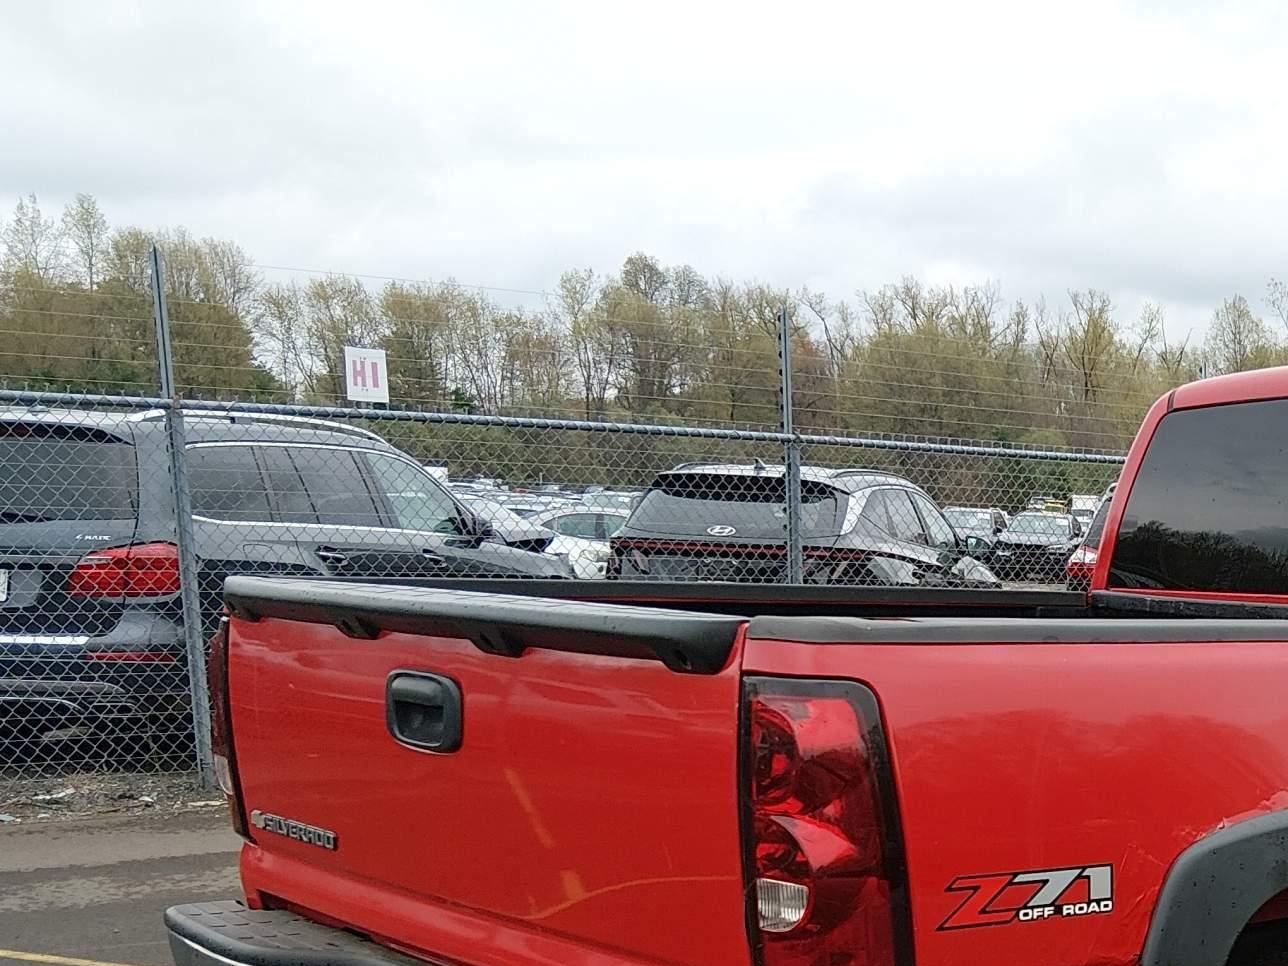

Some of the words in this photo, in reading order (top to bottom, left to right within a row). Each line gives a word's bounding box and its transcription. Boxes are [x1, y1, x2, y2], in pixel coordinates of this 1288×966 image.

[264, 814, 337, 850] SILVERADO
[935, 863, 1114, 932] Z71
[1018, 906, 1055, 921] OFF
[1062, 900, 1113, 916] ROAD
